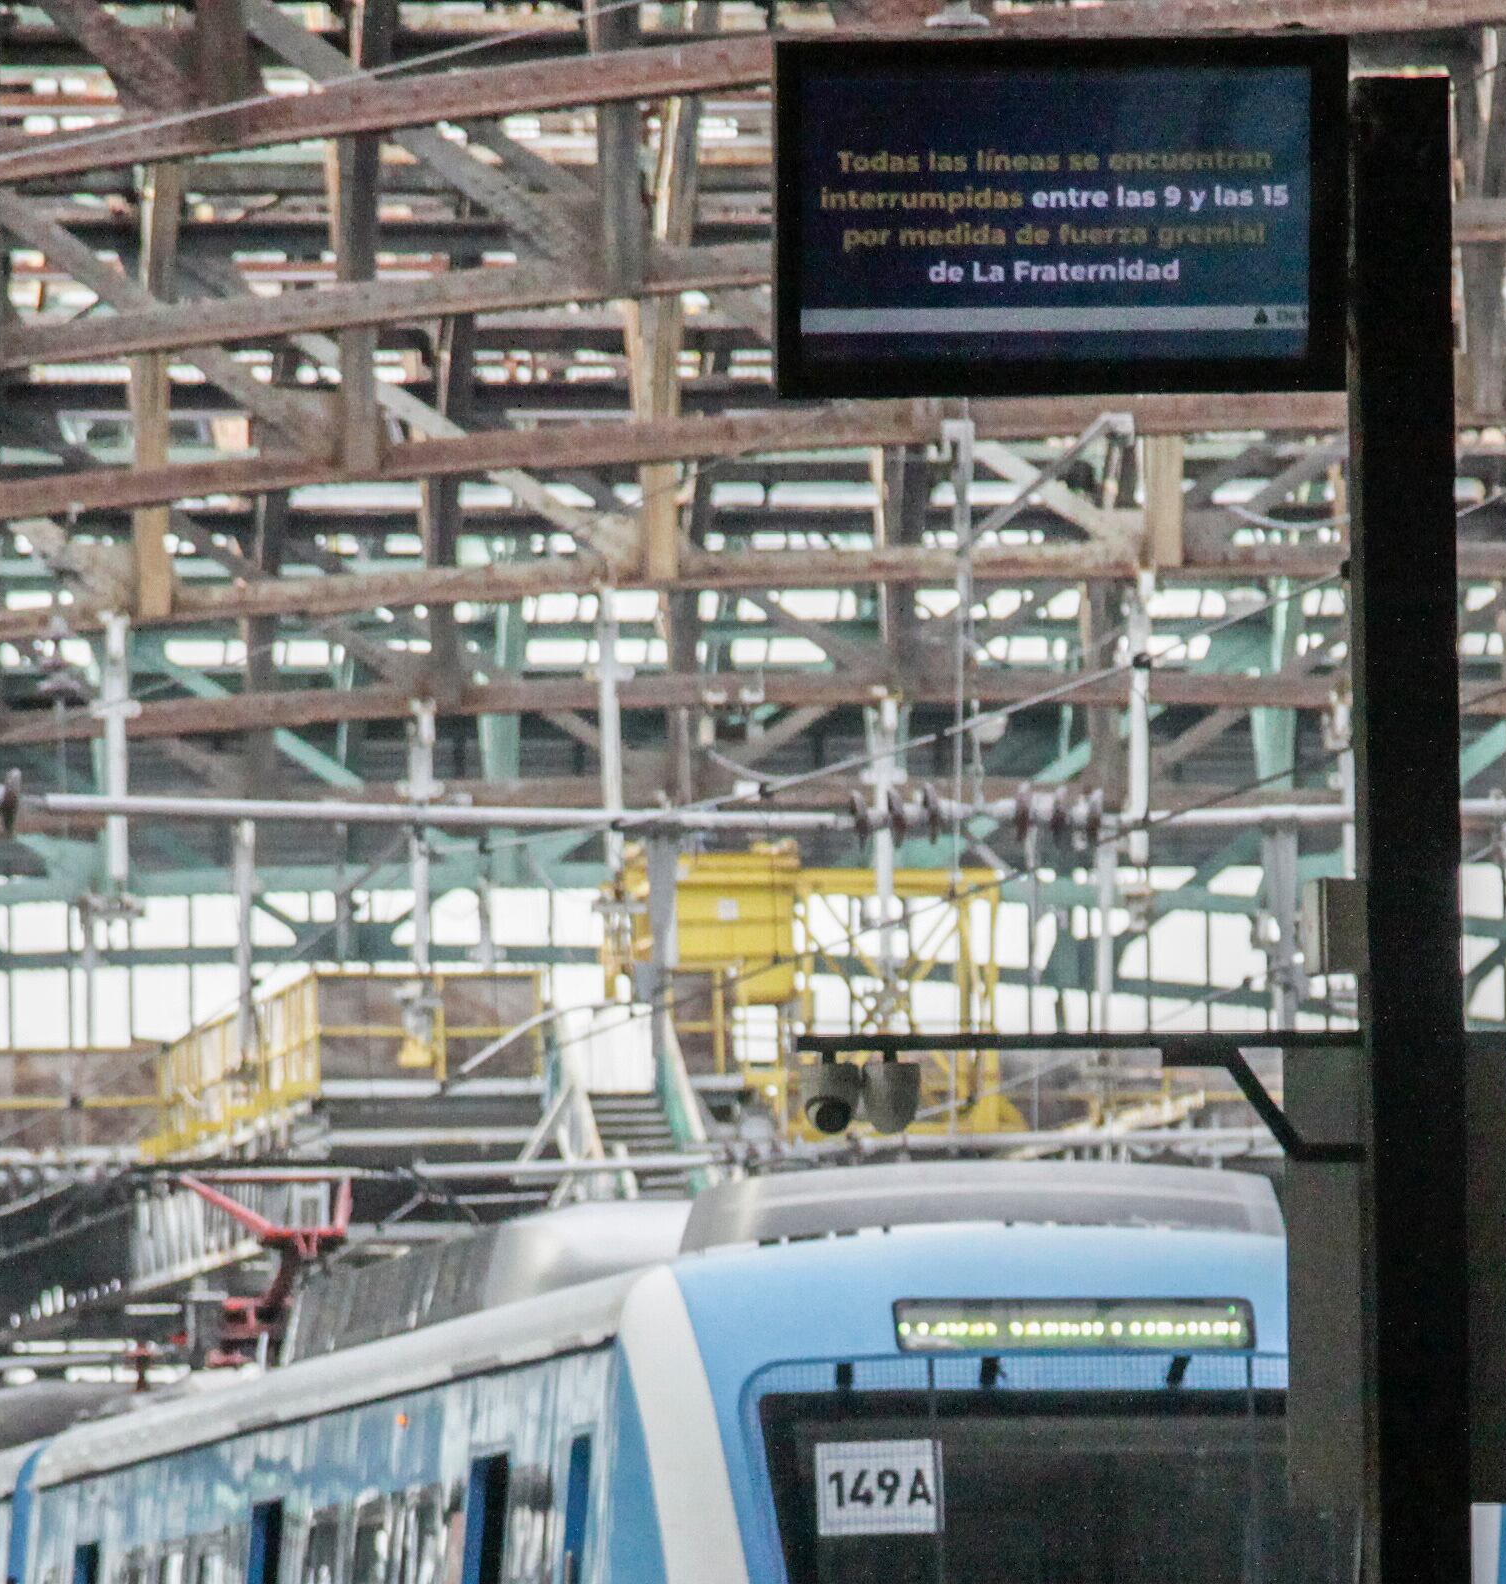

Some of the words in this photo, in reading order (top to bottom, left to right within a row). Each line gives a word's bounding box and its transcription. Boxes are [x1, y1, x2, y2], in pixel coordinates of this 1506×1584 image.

[837, 150, 920, 174] Todas
[929, 150, 967, 172] las
[977, 148, 1059, 172] líneas
[1069, 154, 1099, 171] se
[1108, 150, 1273, 171] encuentran
[820, 187, 1023, 214] interrumpidas
[1032, 188, 1109, 208] entre
[1116, 186, 1156, 207] las
[1163, 186, 1182, 207] 9
[1189, 191, 1206, 213] y
[1214, 185, 1253, 207] las
[1261, 185, 1288, 207] 15
[843, 228, 889, 252] por
[899, 223, 1006, 247] medida
[1015, 223, 1049, 246] de
[1060, 223, 1147, 244] fuerza
[1157, 222, 1265, 248] gremial
[928, 262, 964, 284] de
[973, 261, 1005, 283] La
[1014, 259, 1180, 282] Fraternidad
[828, 1468, 933, 1508] 149A
